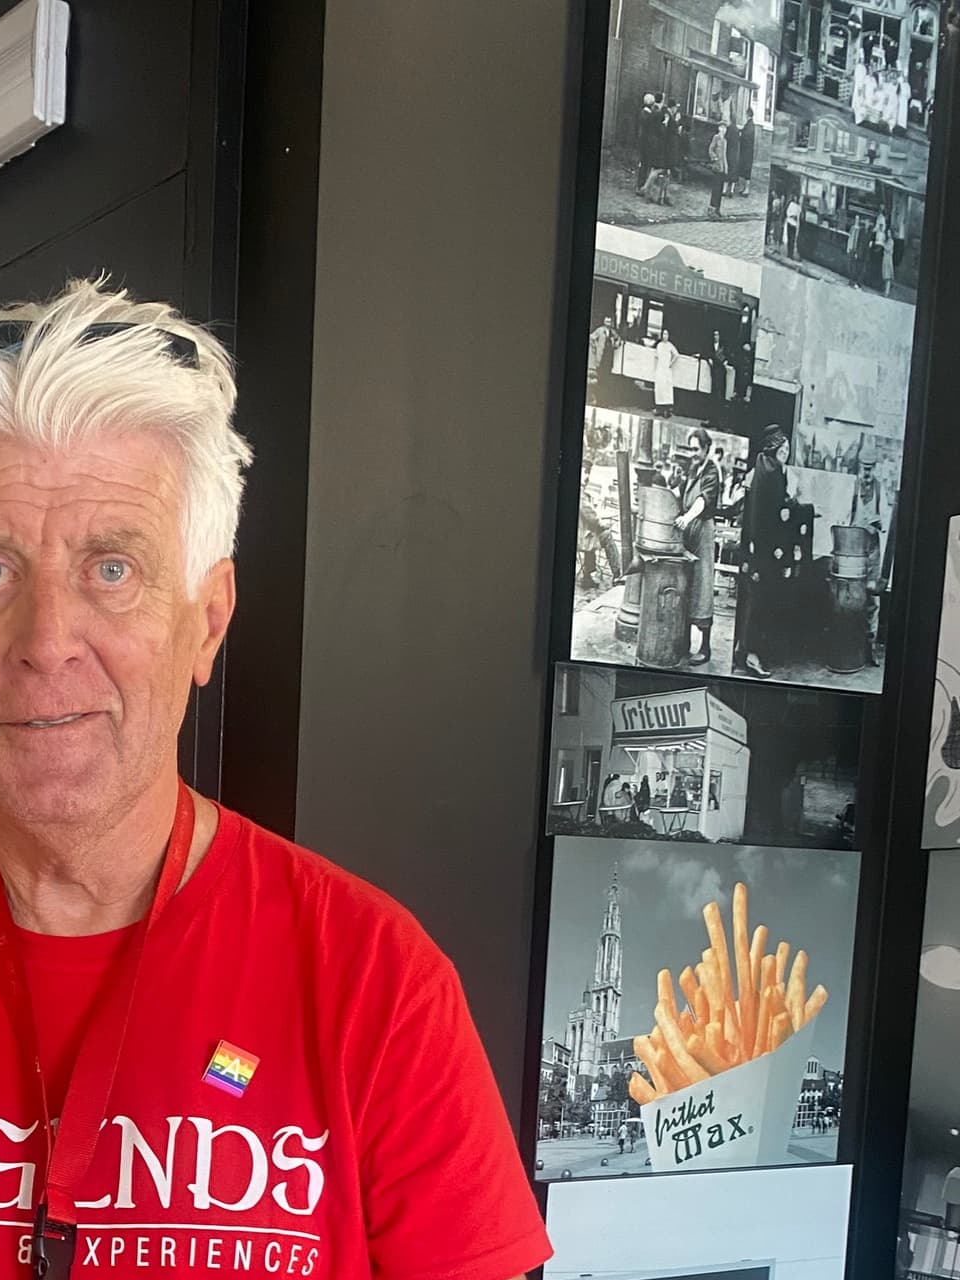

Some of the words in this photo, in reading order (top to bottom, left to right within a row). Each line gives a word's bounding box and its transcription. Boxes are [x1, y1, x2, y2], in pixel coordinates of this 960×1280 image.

[674, 273, 737, 304] FRITURE
[655, 1090, 715, 1147] fritkot
[80, 1235, 320, 1277] XPERIENCES
